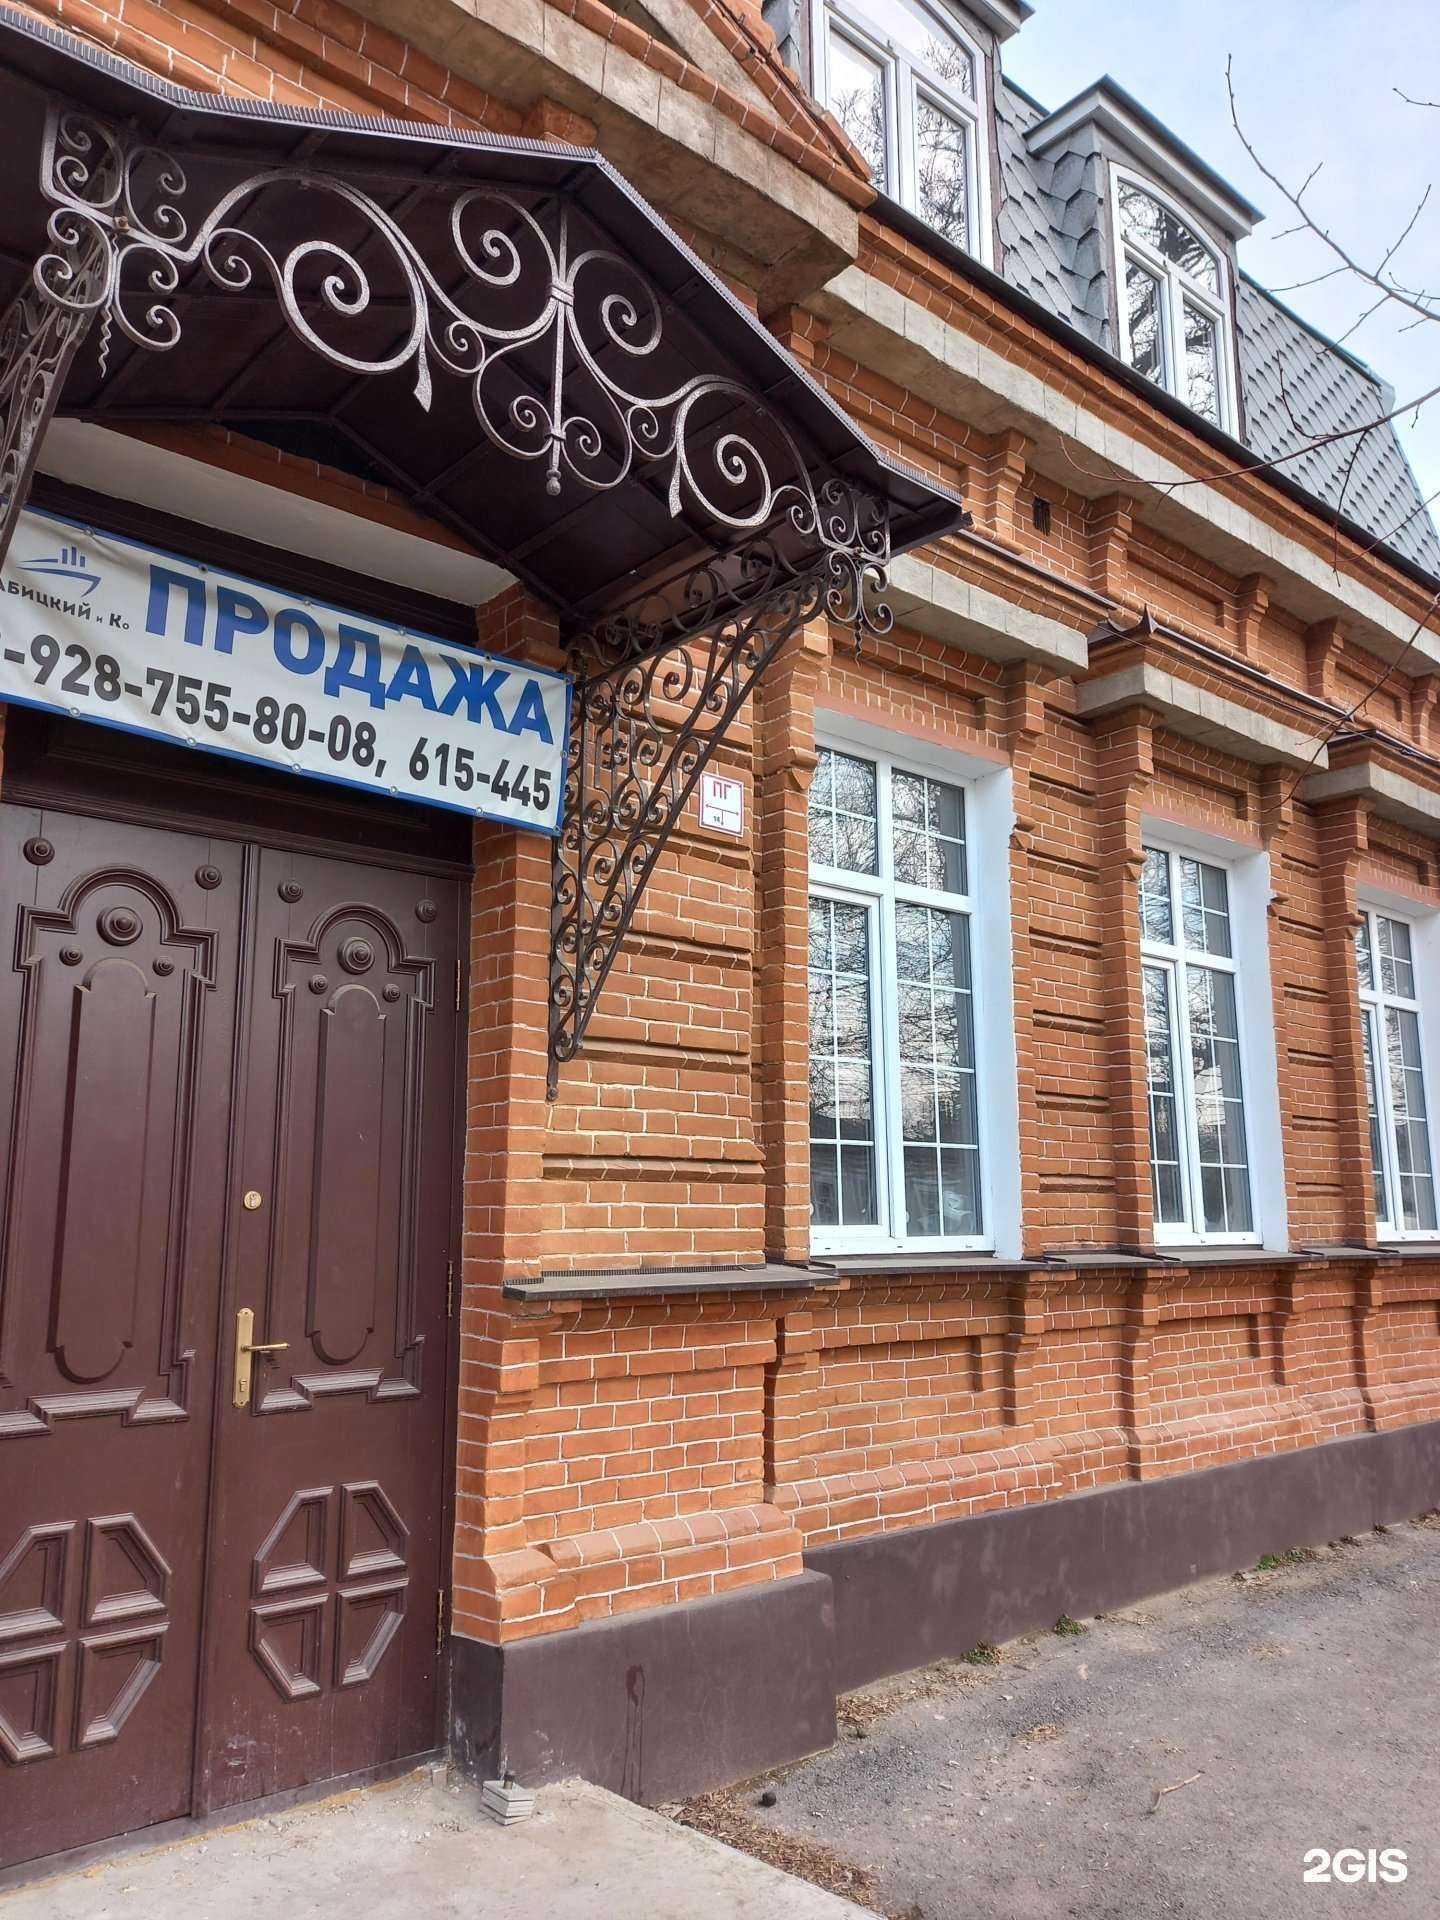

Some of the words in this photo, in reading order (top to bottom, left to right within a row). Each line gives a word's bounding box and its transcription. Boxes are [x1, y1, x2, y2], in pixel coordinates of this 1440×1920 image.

[0, 631, 387, 778] -928-755-80-08,
[408, 736, 552, 812] 615-445
[145, 563, 554, 745] ПРОДАЖА
[713, 781, 731, 799] ПГ
